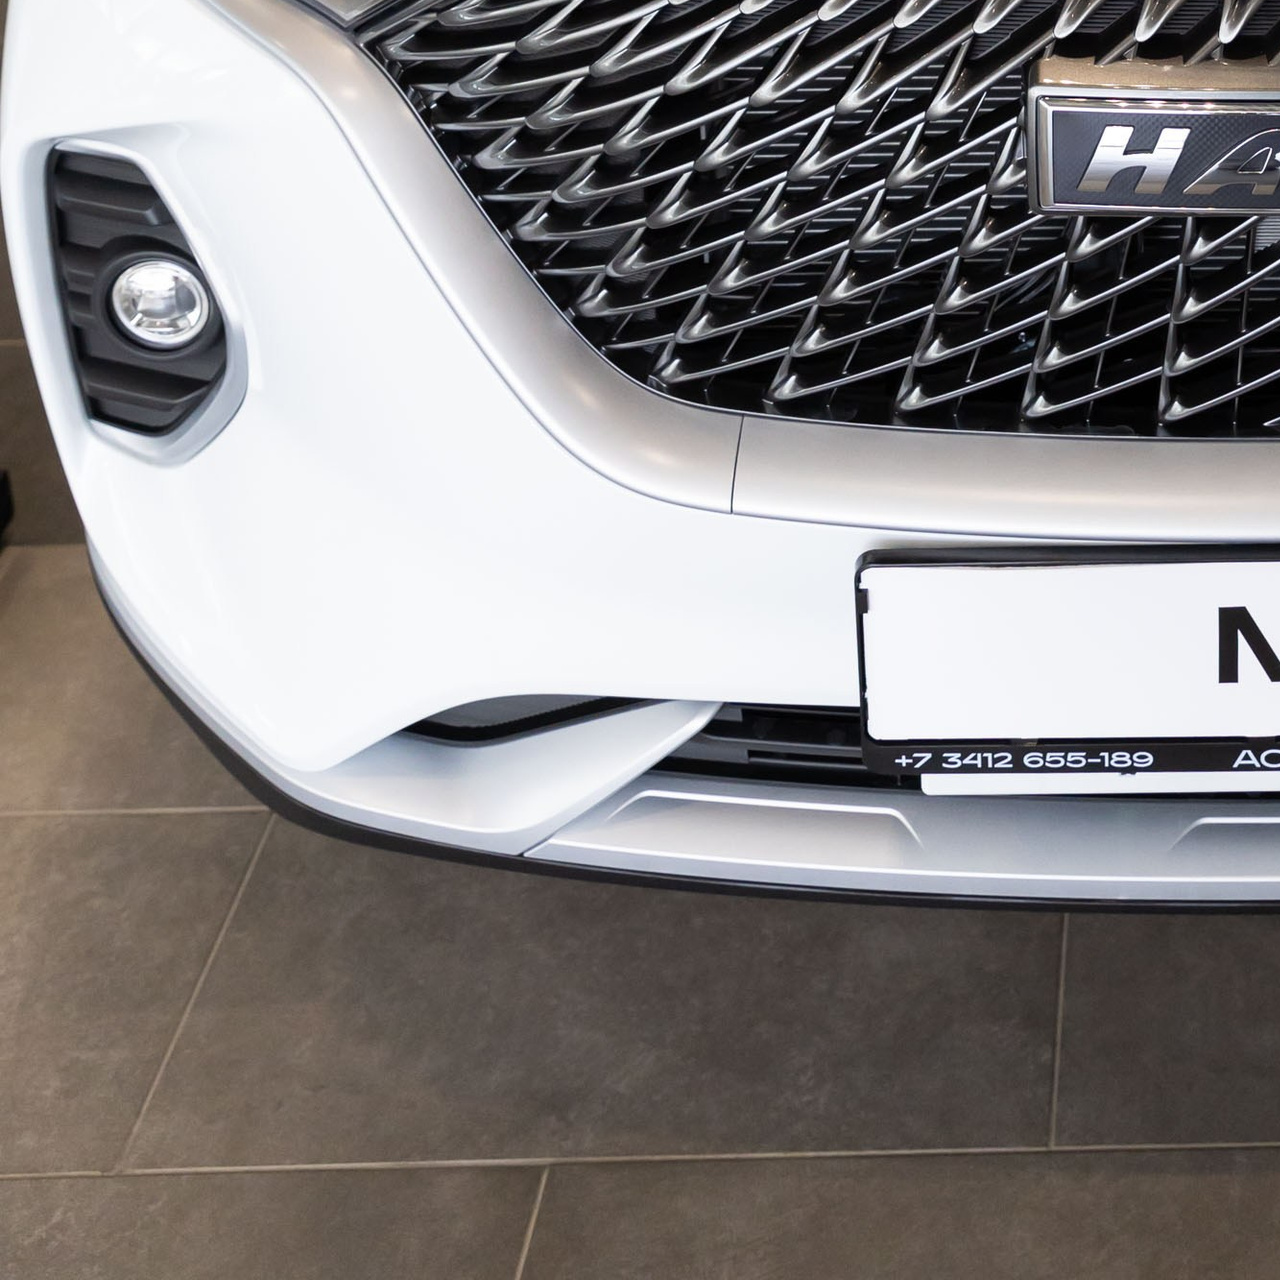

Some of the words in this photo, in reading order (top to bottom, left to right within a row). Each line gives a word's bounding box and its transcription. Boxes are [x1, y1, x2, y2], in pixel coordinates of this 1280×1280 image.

[894, 752, 932, 769] +7
[941, 752, 1013, 769] 3412
[1022, 751, 1154, 769] 655-189
